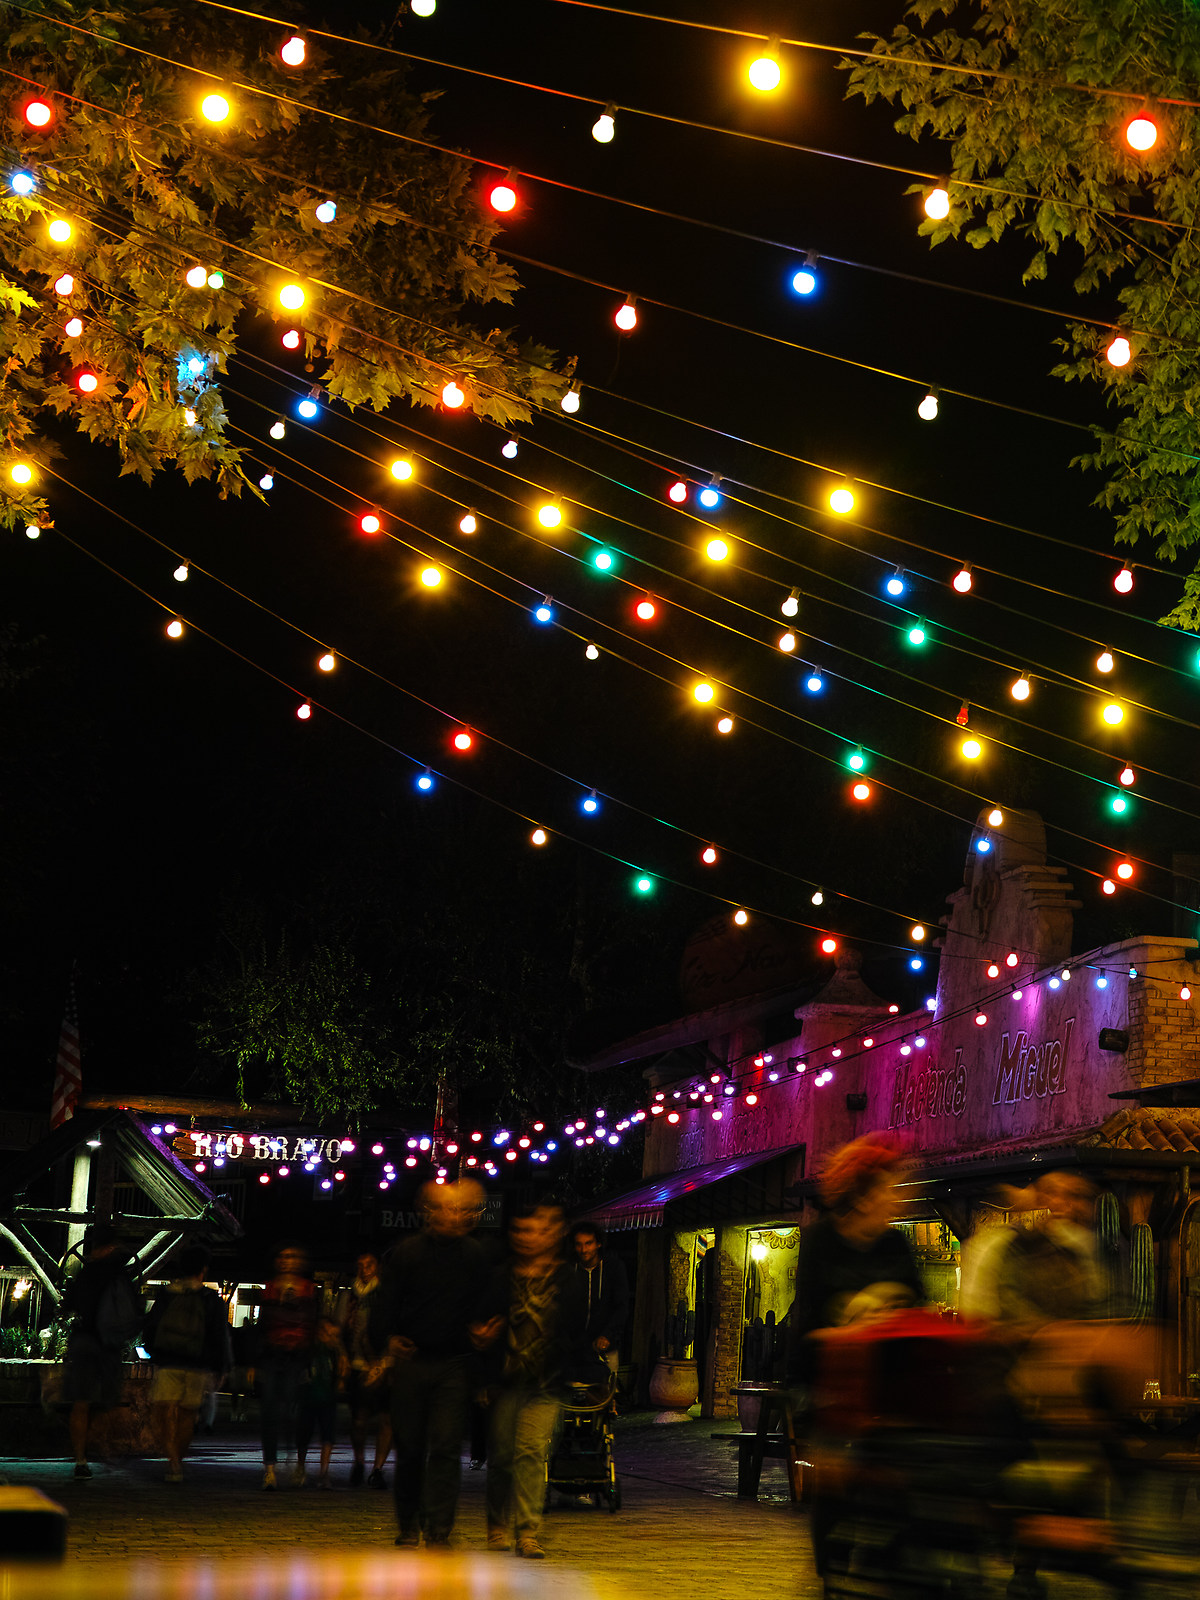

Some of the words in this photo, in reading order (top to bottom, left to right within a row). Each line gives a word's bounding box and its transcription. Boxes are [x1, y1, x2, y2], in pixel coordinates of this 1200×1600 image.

[887, 1047, 968, 1130] Hacienda
[992, 1017, 1076, 1106] Miguel
[192, 1132, 244, 1159] RIO
[252, 1135, 343, 1164] BRAVO
